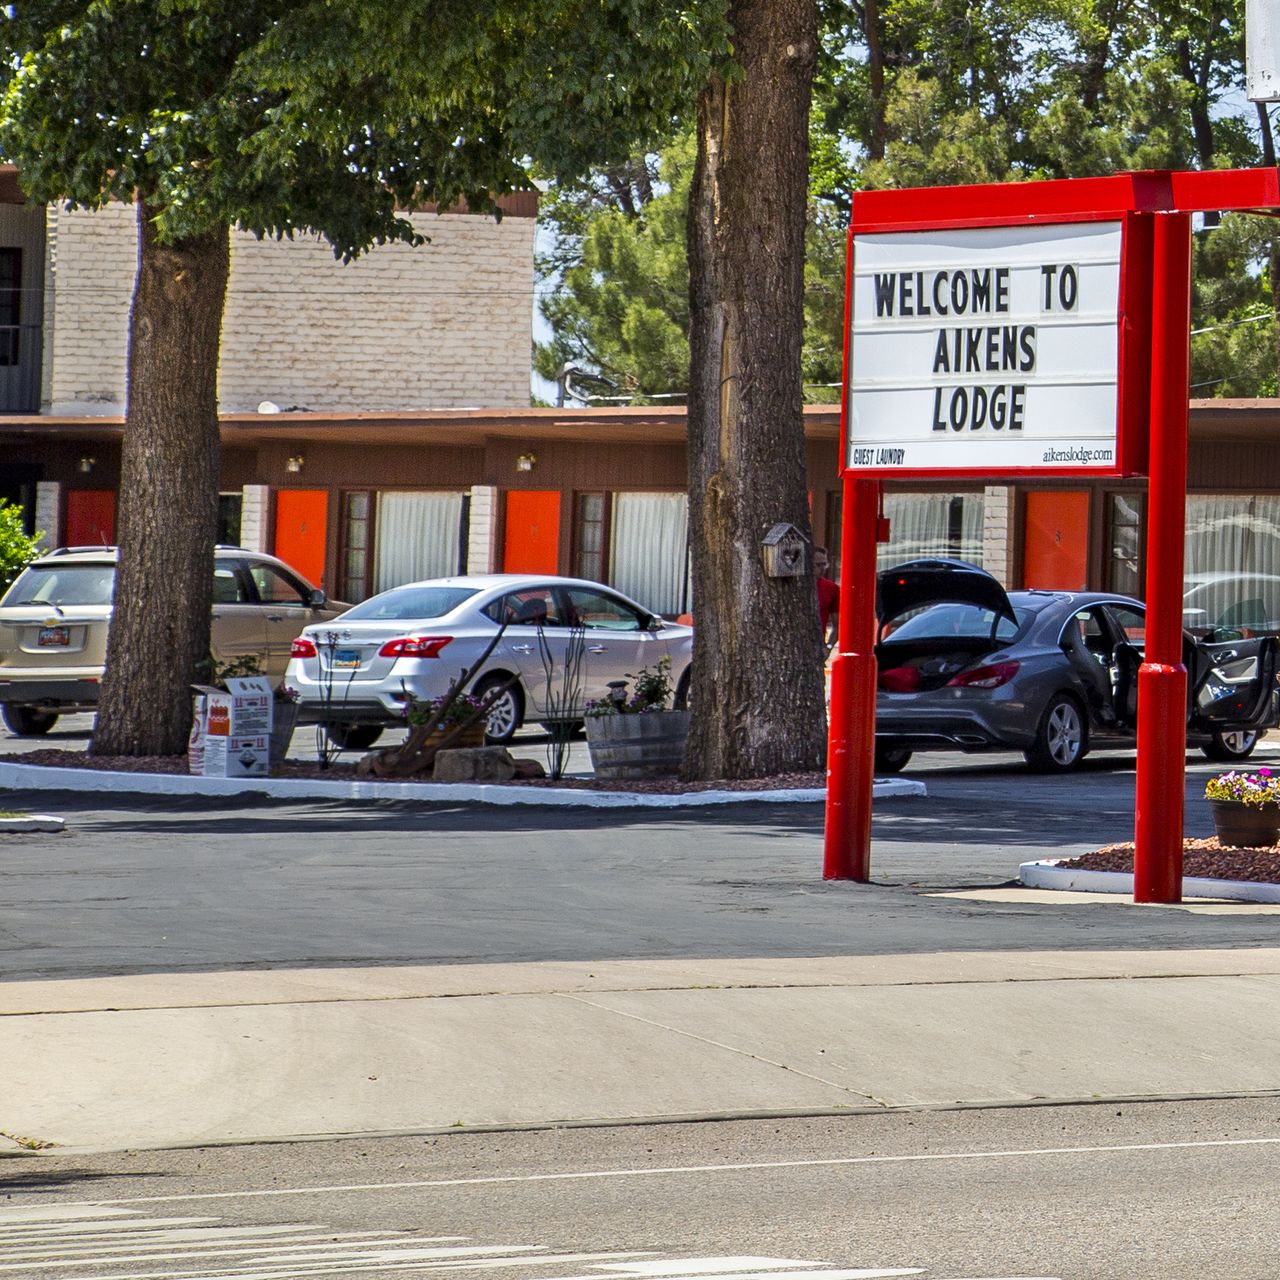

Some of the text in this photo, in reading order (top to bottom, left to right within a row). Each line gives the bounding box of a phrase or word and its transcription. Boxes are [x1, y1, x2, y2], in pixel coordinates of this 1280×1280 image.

[874, 264, 1078, 317] WELCOME TO
[932, 325, 1036, 373] AIKENS
[932, 384, 1025, 432] LODGE
[853, 448, 905, 465] GUEST LAUNDRY
[1042, 446, 1113, 464] aikenslodge.com
